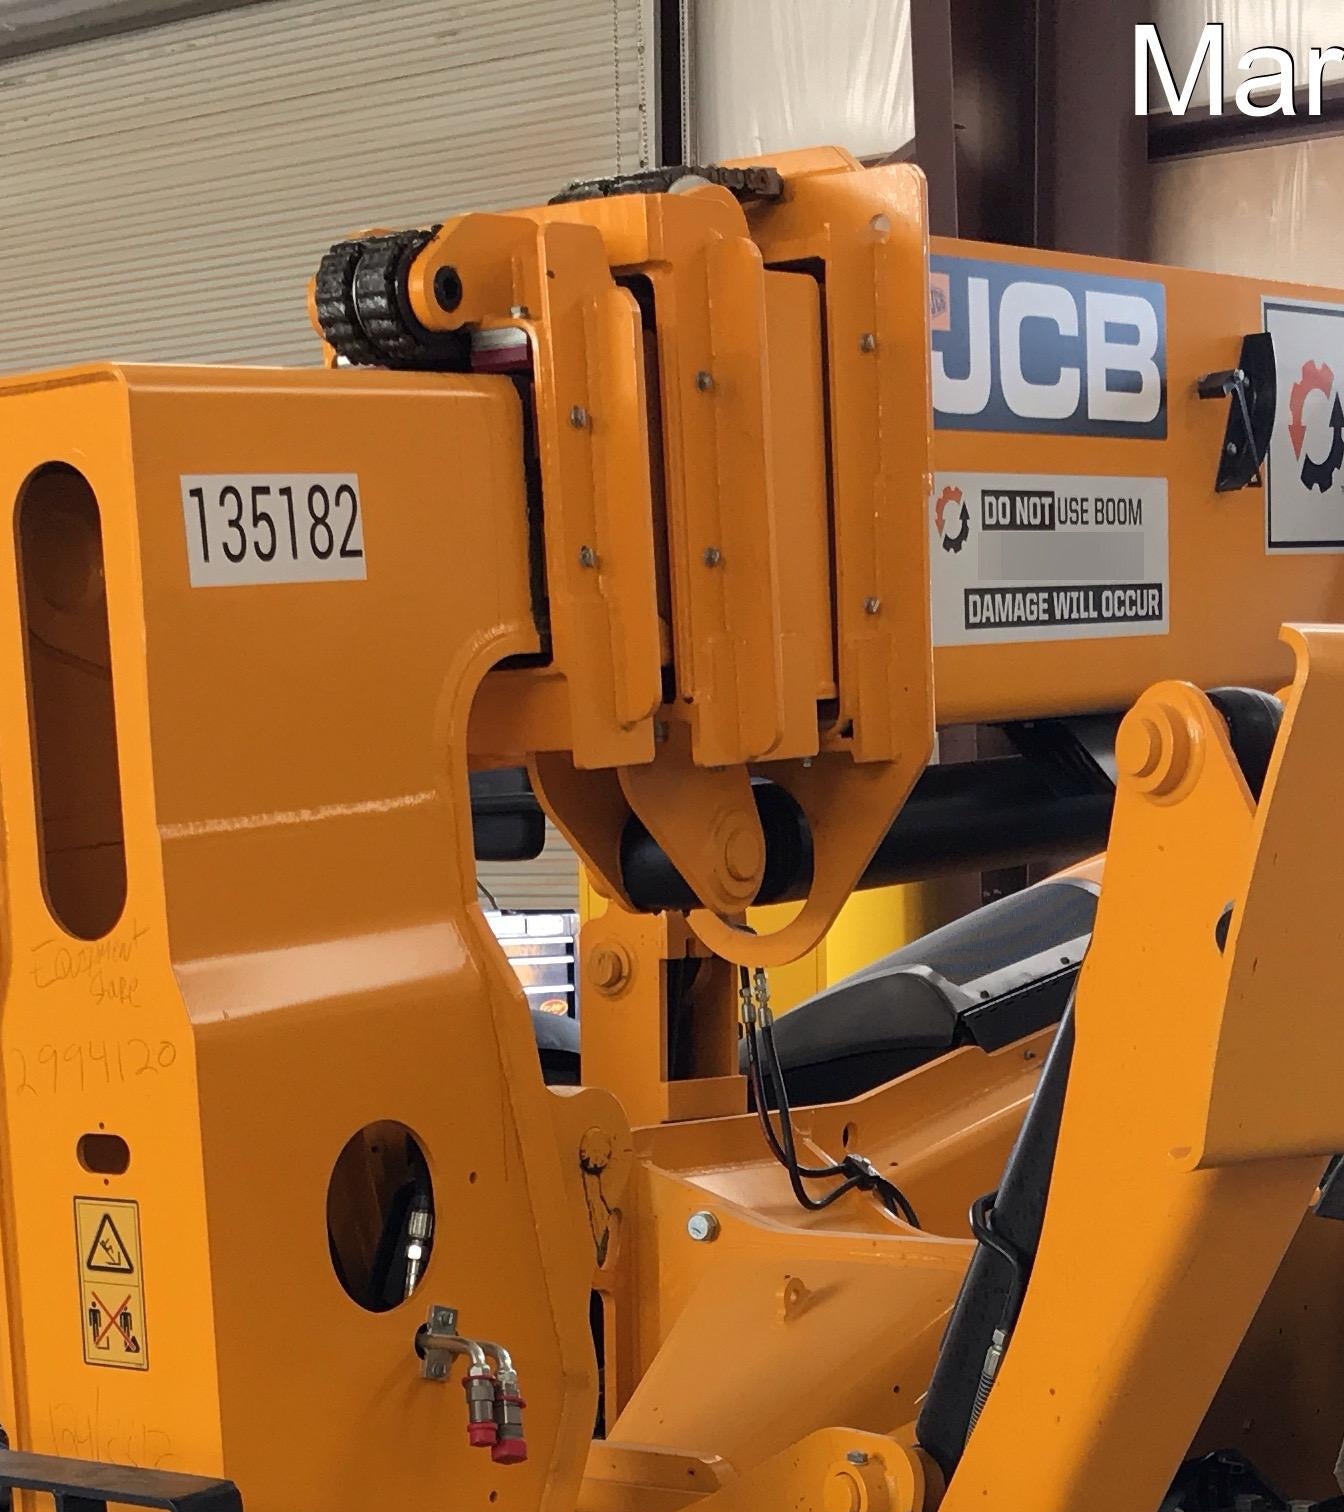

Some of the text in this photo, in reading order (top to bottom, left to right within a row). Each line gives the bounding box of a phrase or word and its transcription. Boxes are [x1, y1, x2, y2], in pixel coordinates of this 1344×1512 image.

[931, 276, 1161, 423] JCB
[189, 483, 363, 563] 135182
[984, 495, 1143, 527] DO NOT USE BOOM
[967, 588, 1160, 624] DAMAGE WILL OCCUR
